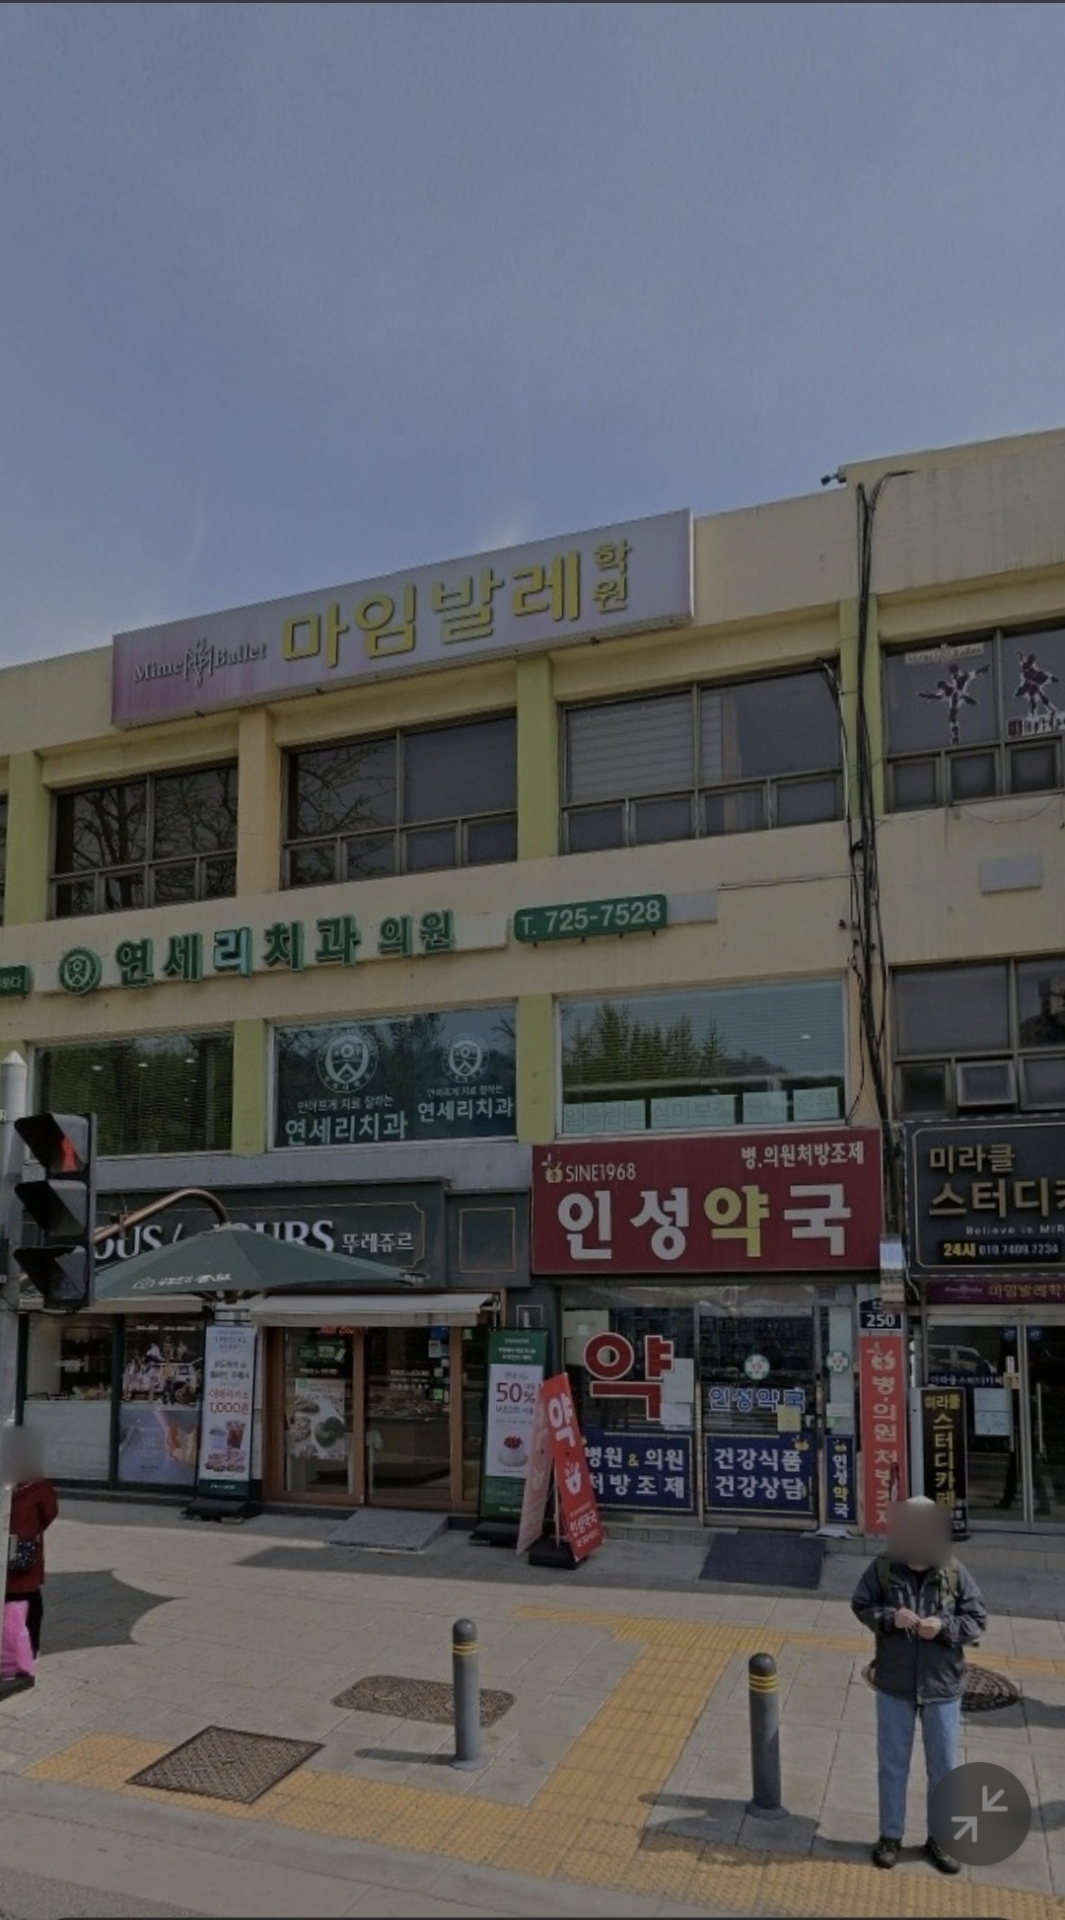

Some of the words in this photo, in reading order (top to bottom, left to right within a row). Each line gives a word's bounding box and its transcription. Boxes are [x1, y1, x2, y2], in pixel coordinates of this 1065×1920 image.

[593, 539, 632, 614] 학원
[281, 549, 581, 669] 마임발레
[133, 660, 184, 683] Mime
[215, 643, 268, 669] Ballet
[520, 916, 537, 936] T.
[544, 899, 662, 933] 725-7528
[115, 914, 361, 988] 연세리치과
[377, 909, 456, 957] 의원
[417, 1096, 514, 1124] 연세리치과
[284, 1109, 409, 1147] 연세리치과
[565, 1162, 637, 1182] SINE1968
[929, 1143, 1016, 1174] 미라클
[928, 1176, 1065, 1219] 스터디
[557, 1184, 852, 1260] 인성약국
[965, 1225, 1016, 1236] Believe
[93, 1224, 163, 1260] OUS
[341, 1232, 415, 1254] 뚜레쥬르
[943, 1242, 976, 1258] 24시
[988, 1283, 1065, 1299] 마임발레학
[866, 1314, 896, 1327] 250
[583, 1332, 675, 1421] 약
[208, 1402, 250, 1415] 1,000원
[708, 1387, 806, 1414] 인성약국
[923, 1393, 961, 1411] 미라클
[547, 1391, 576, 1448] 약
[584, 1446, 623, 1469] 병원
[628, 1453, 640, 1467] &
[644, 1448, 685, 1472] 의원
[714, 1448, 803, 1473] 건강식품
[589, 1472, 685, 1499] 처방조제
[715, 1475, 806, 1500] 건강상담
[832, 1453, 850, 1519] 인성약국
